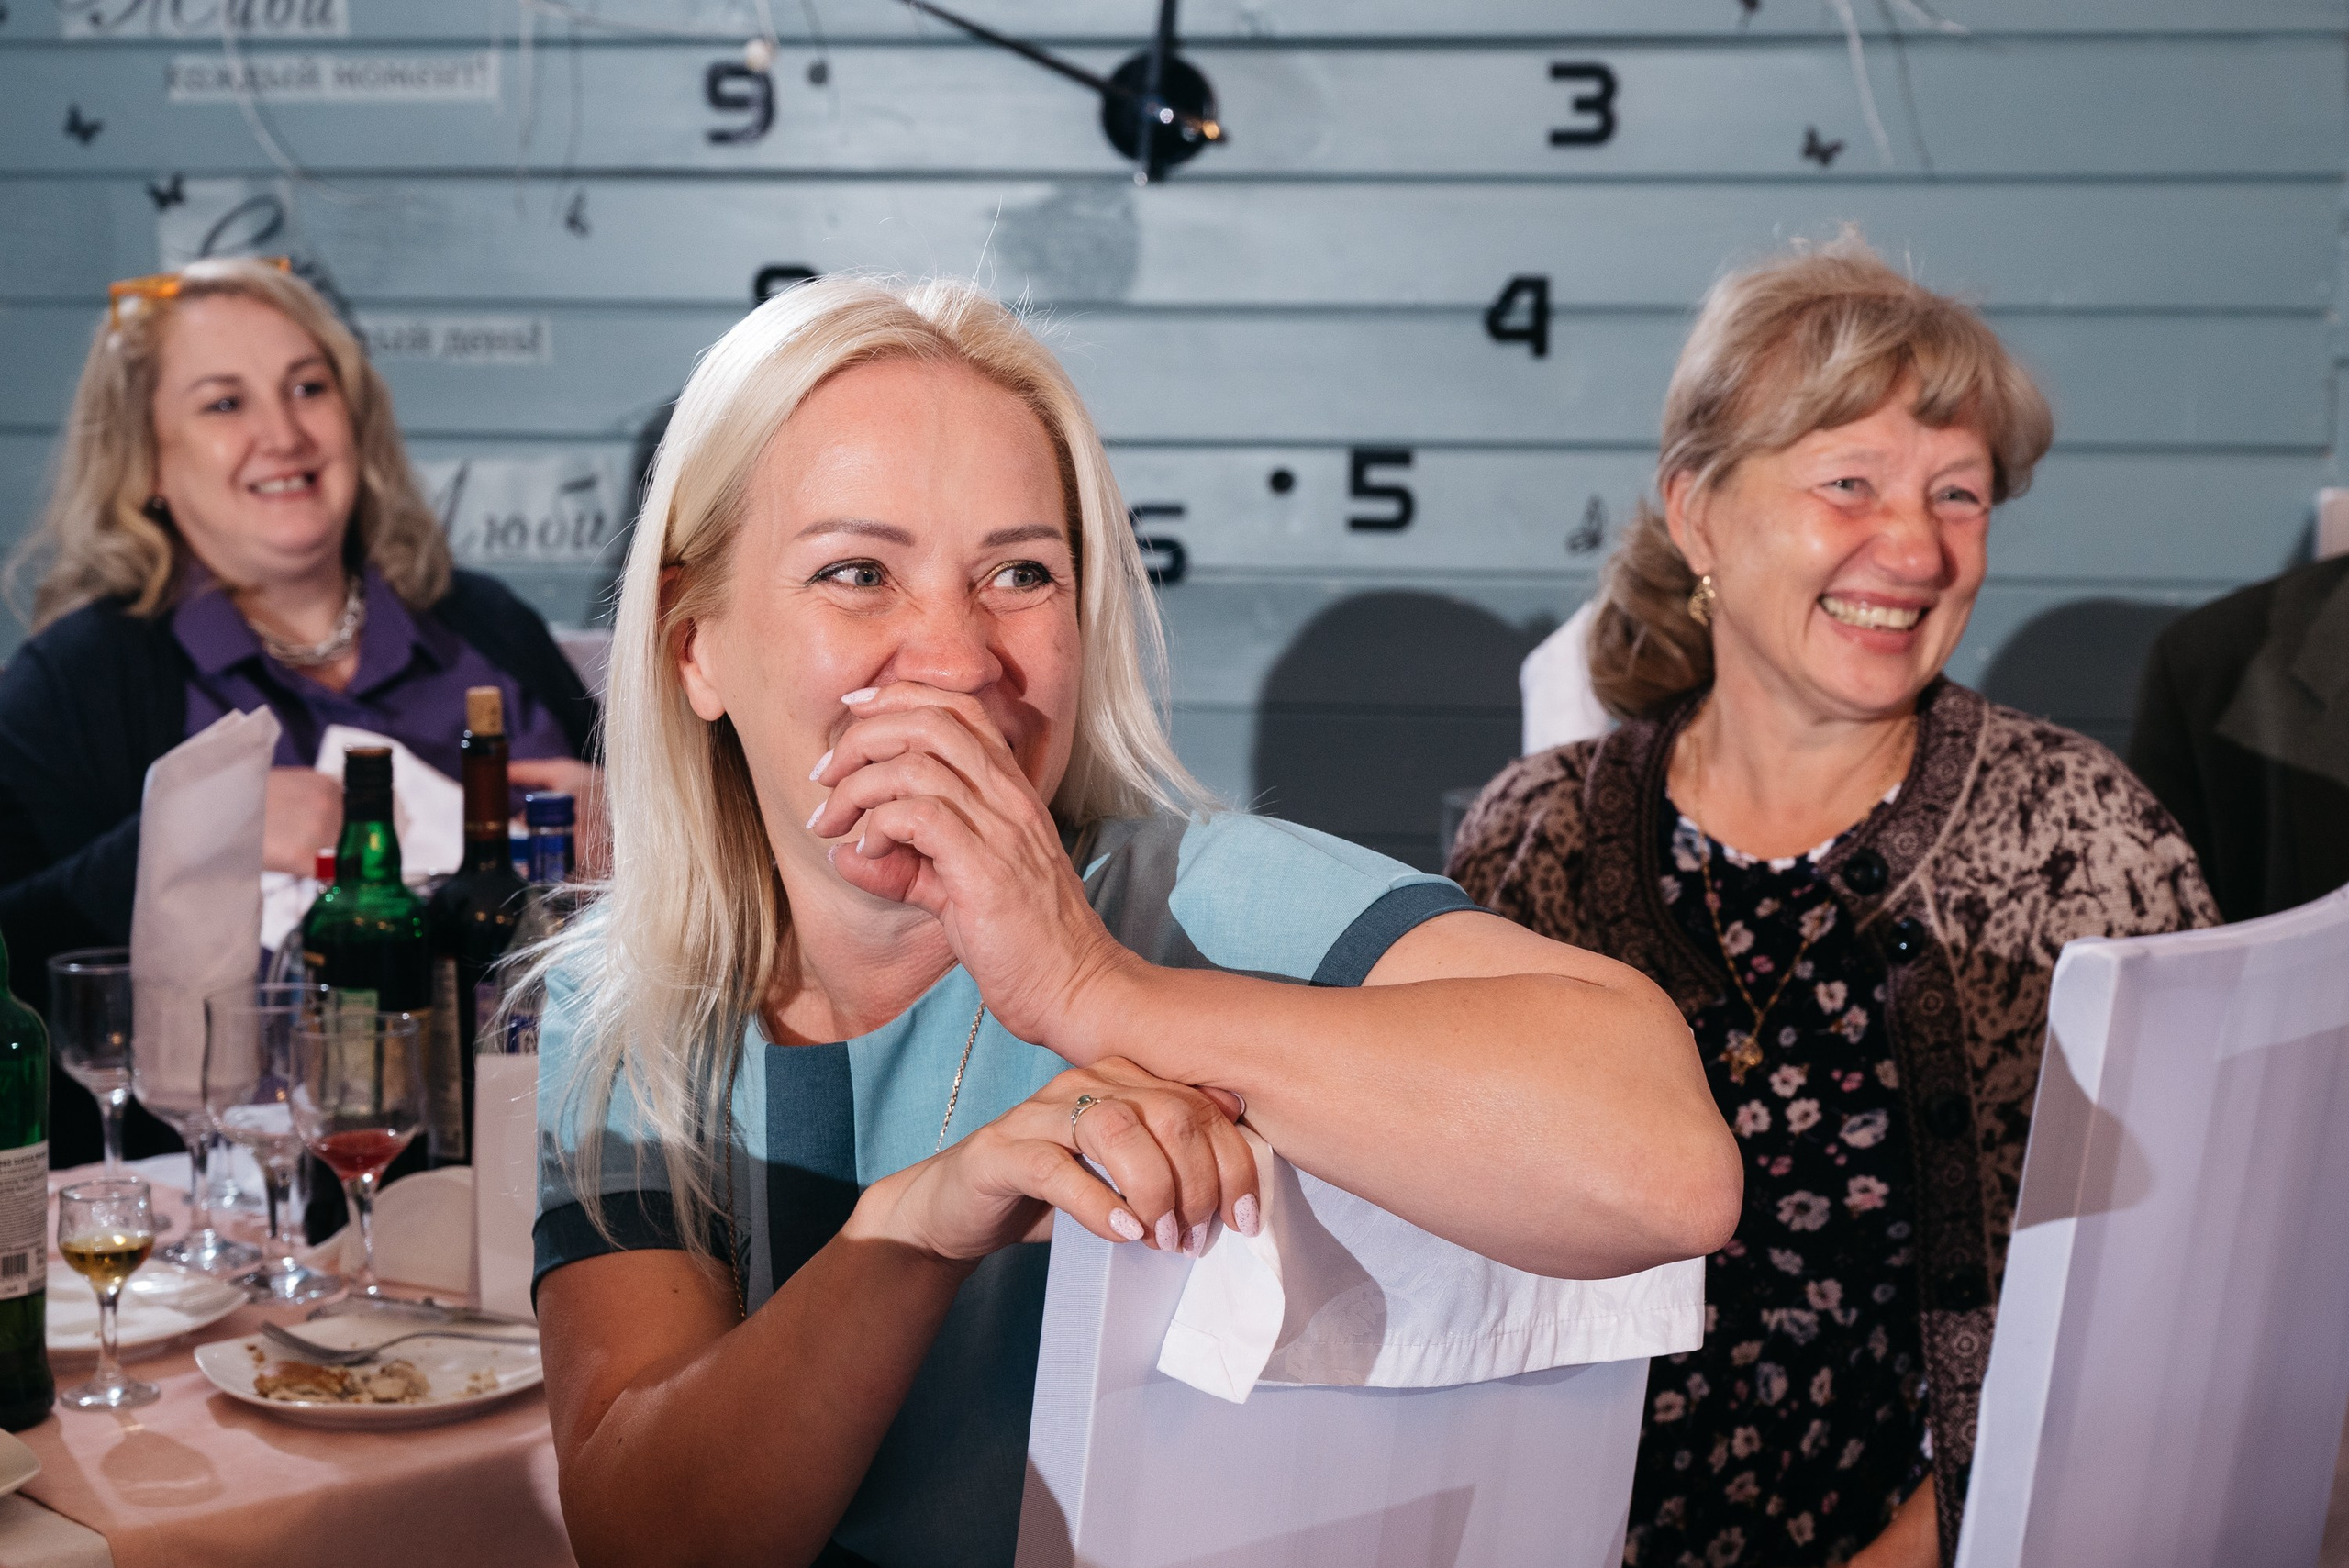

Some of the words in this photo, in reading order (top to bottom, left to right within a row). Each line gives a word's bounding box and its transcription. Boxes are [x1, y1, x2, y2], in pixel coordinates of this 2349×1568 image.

[704, 61, 775, 145] 9
[1548, 61, 1618, 147] 3
[1484, 274, 1551, 359] 4
[1346, 448, 1416, 532] 5
